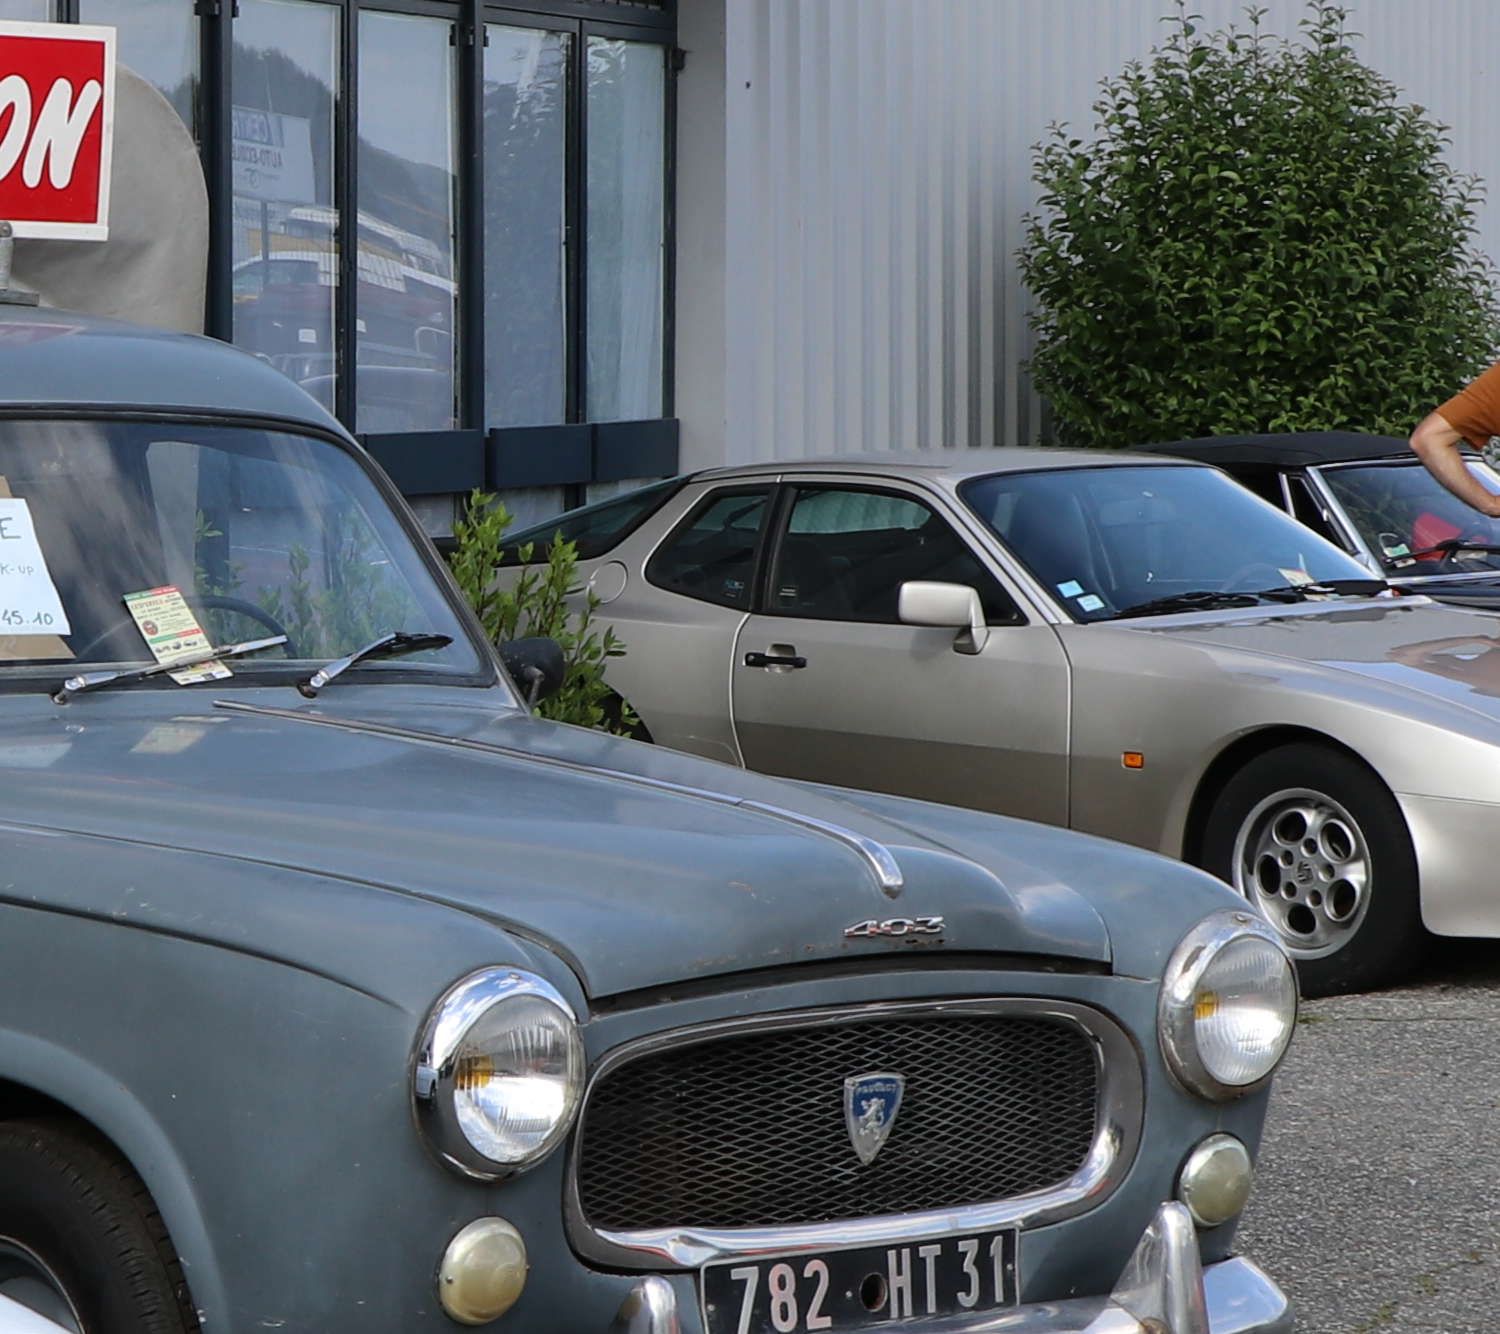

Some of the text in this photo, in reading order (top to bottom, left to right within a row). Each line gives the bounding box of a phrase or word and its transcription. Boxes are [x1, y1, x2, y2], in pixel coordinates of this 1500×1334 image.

[844, 915, 946, 938] 403
[887, 1244, 942, 1319] HT
[957, 1235, 1004, 1308] 31
